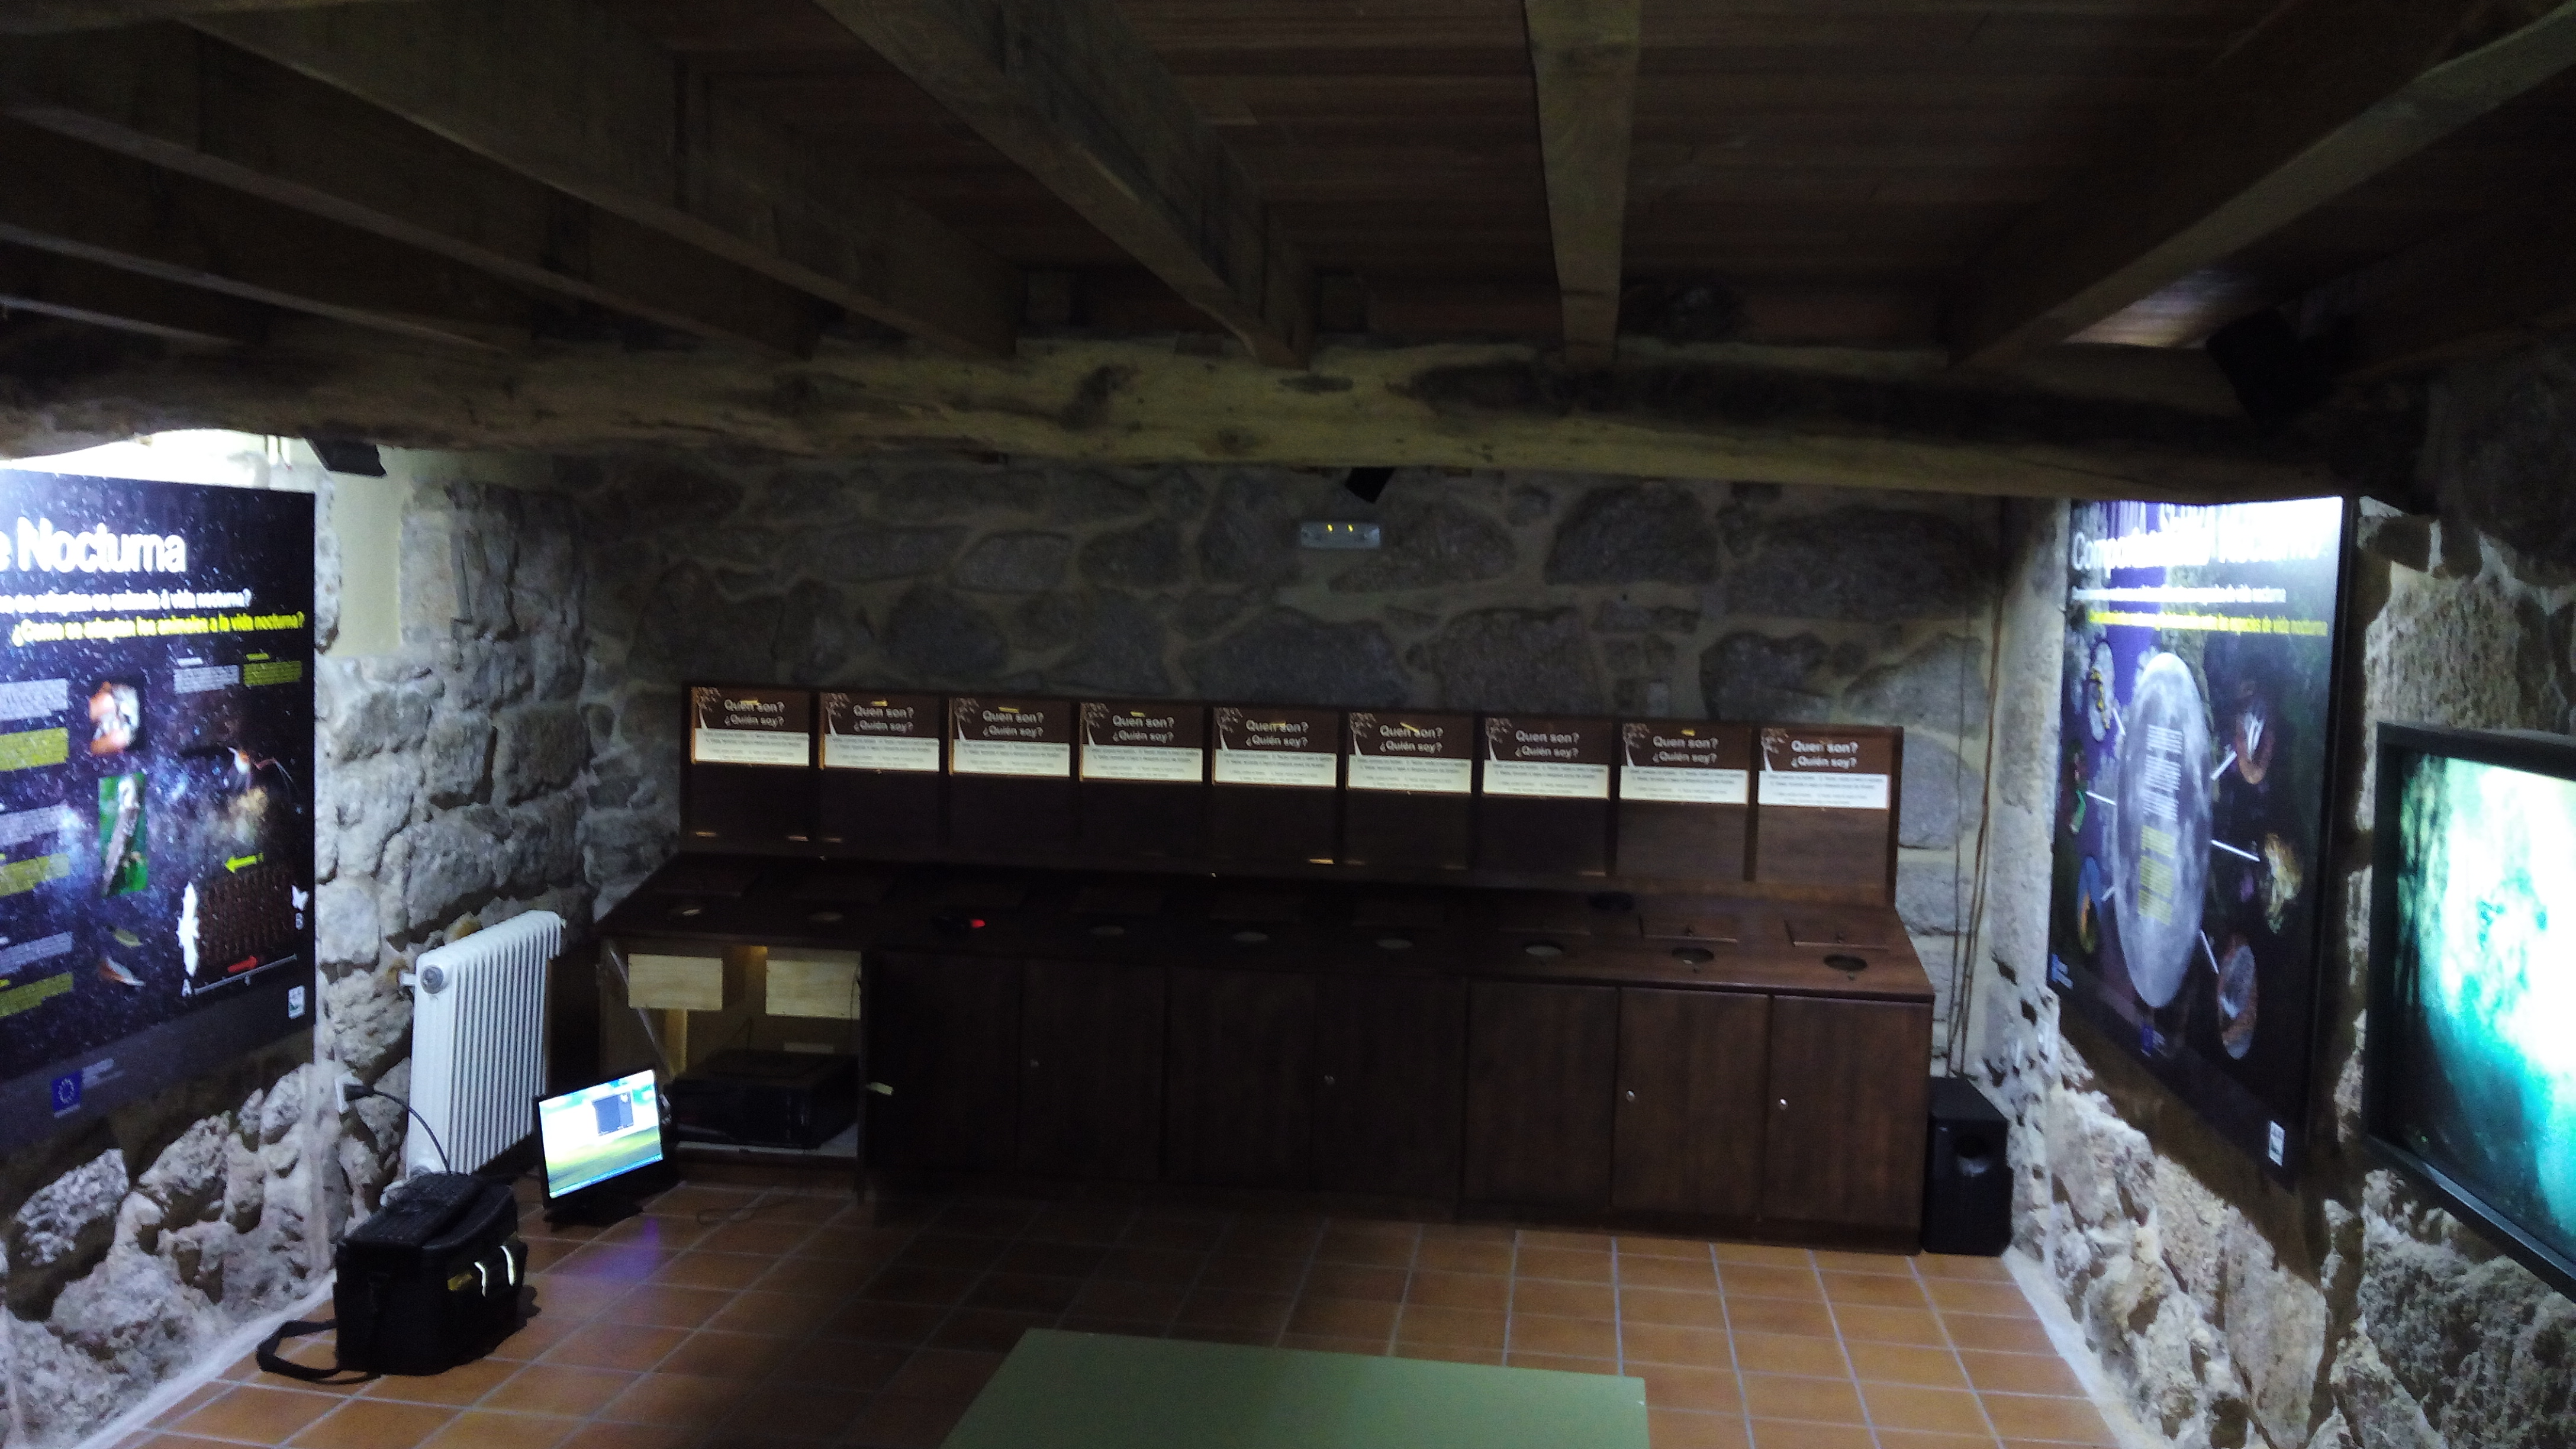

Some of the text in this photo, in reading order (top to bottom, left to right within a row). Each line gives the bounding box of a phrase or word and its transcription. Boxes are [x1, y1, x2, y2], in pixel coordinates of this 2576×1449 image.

[17, 516, 186, 573] Nocturna
[854, 704, 914, 718] Quen son?
[983, 710, 1044, 723] Quen son?
[760, 716, 784, 728] soy?
[1112, 715, 1174, 728] Quen son?
[1246, 719, 1277, 732] Quen
[890, 722, 913, 734] soy?
[1019, 727, 1044, 739] soy?
[1380, 725, 1411, 738] Quen
[1149, 732, 1174, 743] soy?
[1283, 736, 1308, 748] soy?
[1515, 730, 1579, 743] Quen son?
[1653, 736, 1719, 749] Quen son?
[1417, 742, 1442, 754] soy?
[1791, 740, 1859, 753] Quen son?
[1553, 748, 1579, 759] soy?
[1691, 753, 1718, 765] soy?
[1831, 757, 1857, 769] soy?
